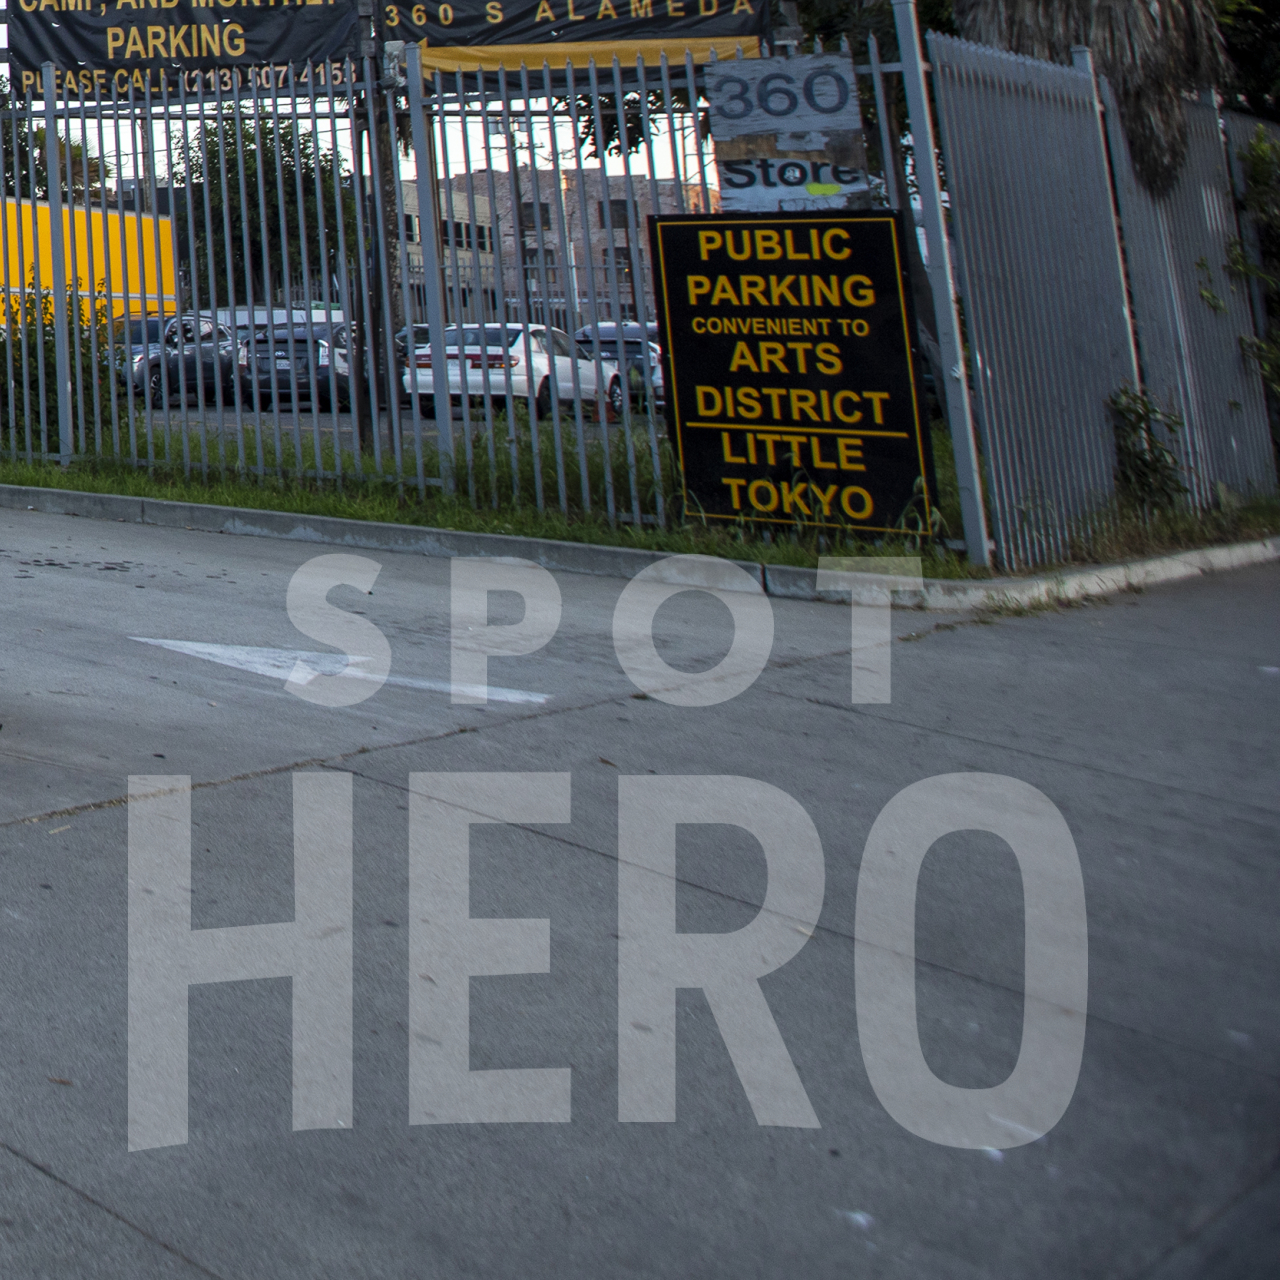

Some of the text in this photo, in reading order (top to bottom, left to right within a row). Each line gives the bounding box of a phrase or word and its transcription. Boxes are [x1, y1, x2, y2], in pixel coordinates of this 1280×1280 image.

[385, 3, 454, 27] 360
[486, 1, 504, 24] S
[107, 23, 246, 59] PARKING
[22, 69, 108, 94] PLEASE
[713, 70, 849, 119] 360
[723, 158, 860, 189] Store
[698, 228, 852, 262] PUBLIC
[686, 274, 875, 308] PARKING
[691, 317, 869, 337] CONVENIENT TO
[729, 341, 842, 376] ARTS
[694, 385, 890, 425] DISTRICT
[721, 431, 867, 472] LITTLE
[721, 477, 874, 520] TOKYO
